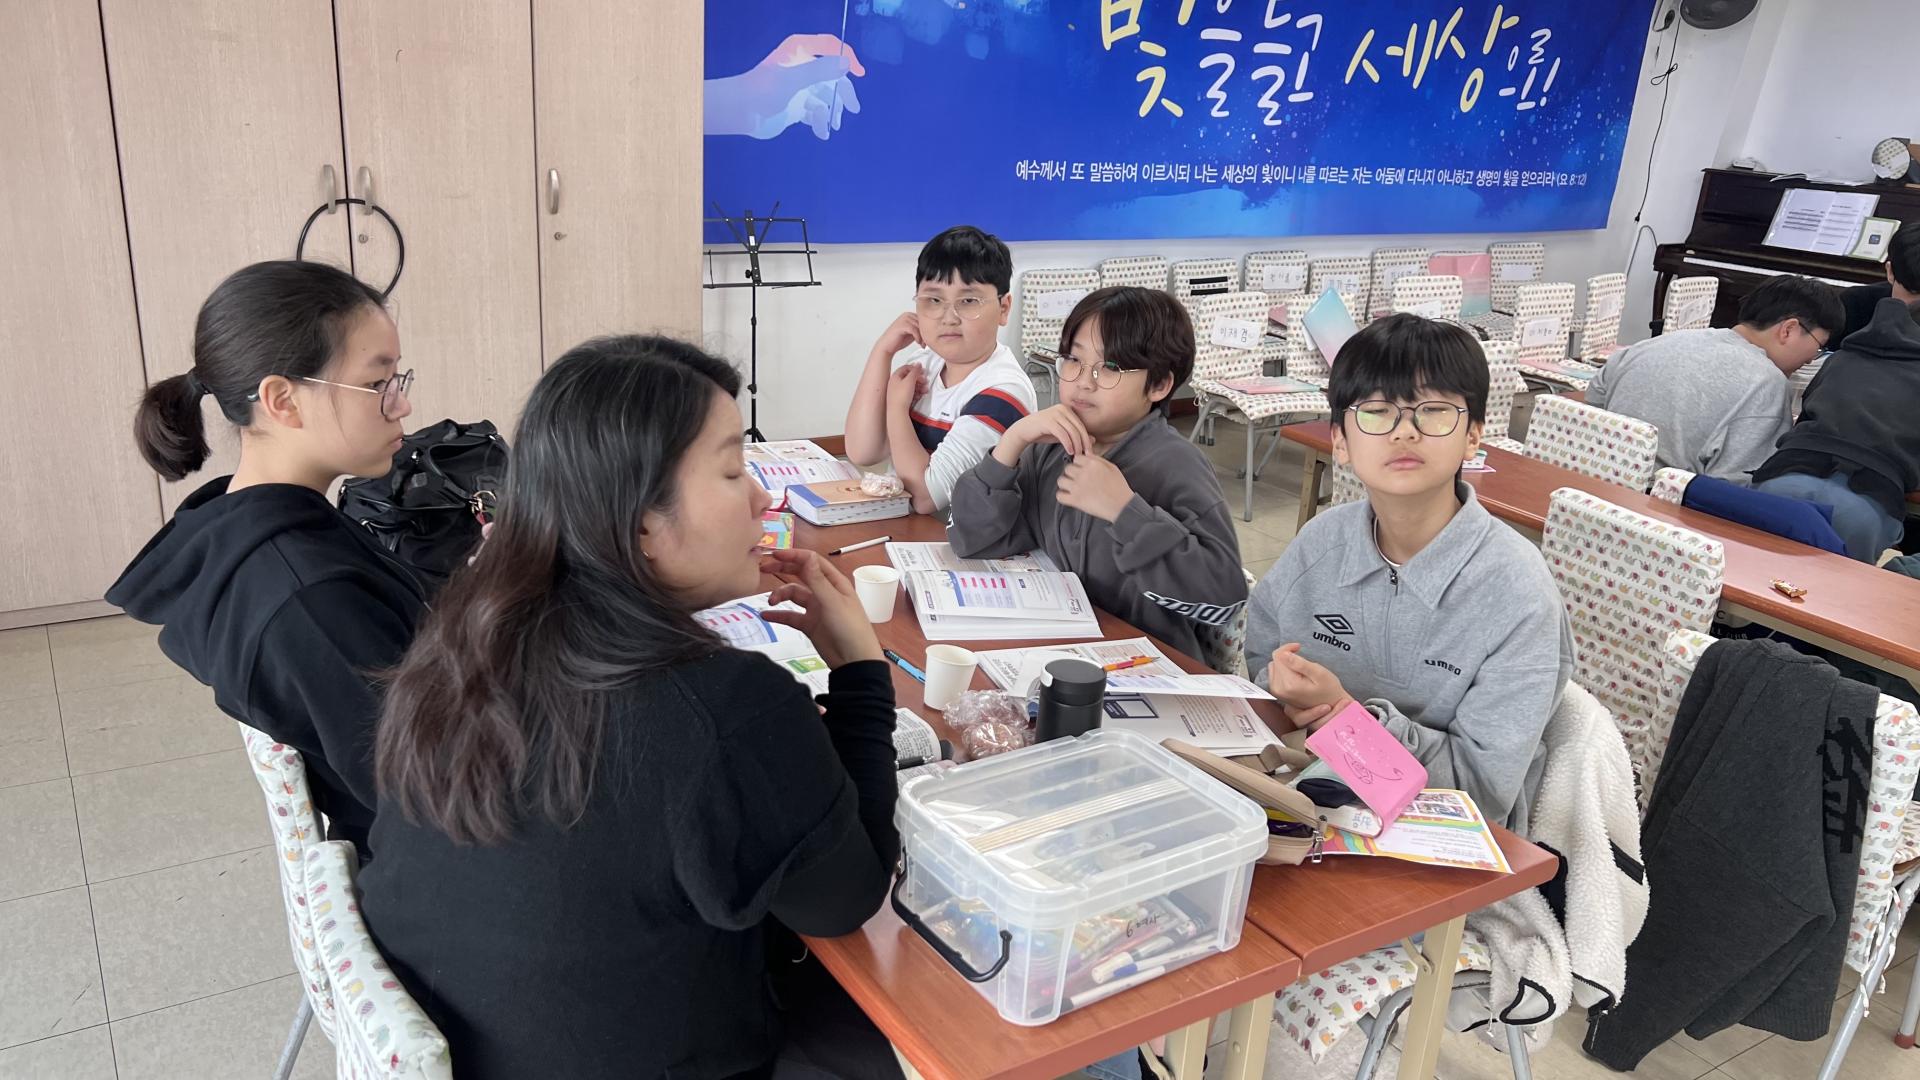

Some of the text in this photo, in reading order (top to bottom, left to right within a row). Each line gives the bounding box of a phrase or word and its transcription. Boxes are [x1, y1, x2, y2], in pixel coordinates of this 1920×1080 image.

[1101, 0, 1243, 117] 빛을
[1344, 4, 1561, 113] 세상으로!
[1015, 159, 1588, 188] 예수께서 또 말씀하여 이르시되 나는 세상의 빛이니 나를 따르는 자는 어둠에 다니지 아니하고 생명의 빛을 얻으리라 (요 8:12)
[1312, 630, 1352, 652] umbro
